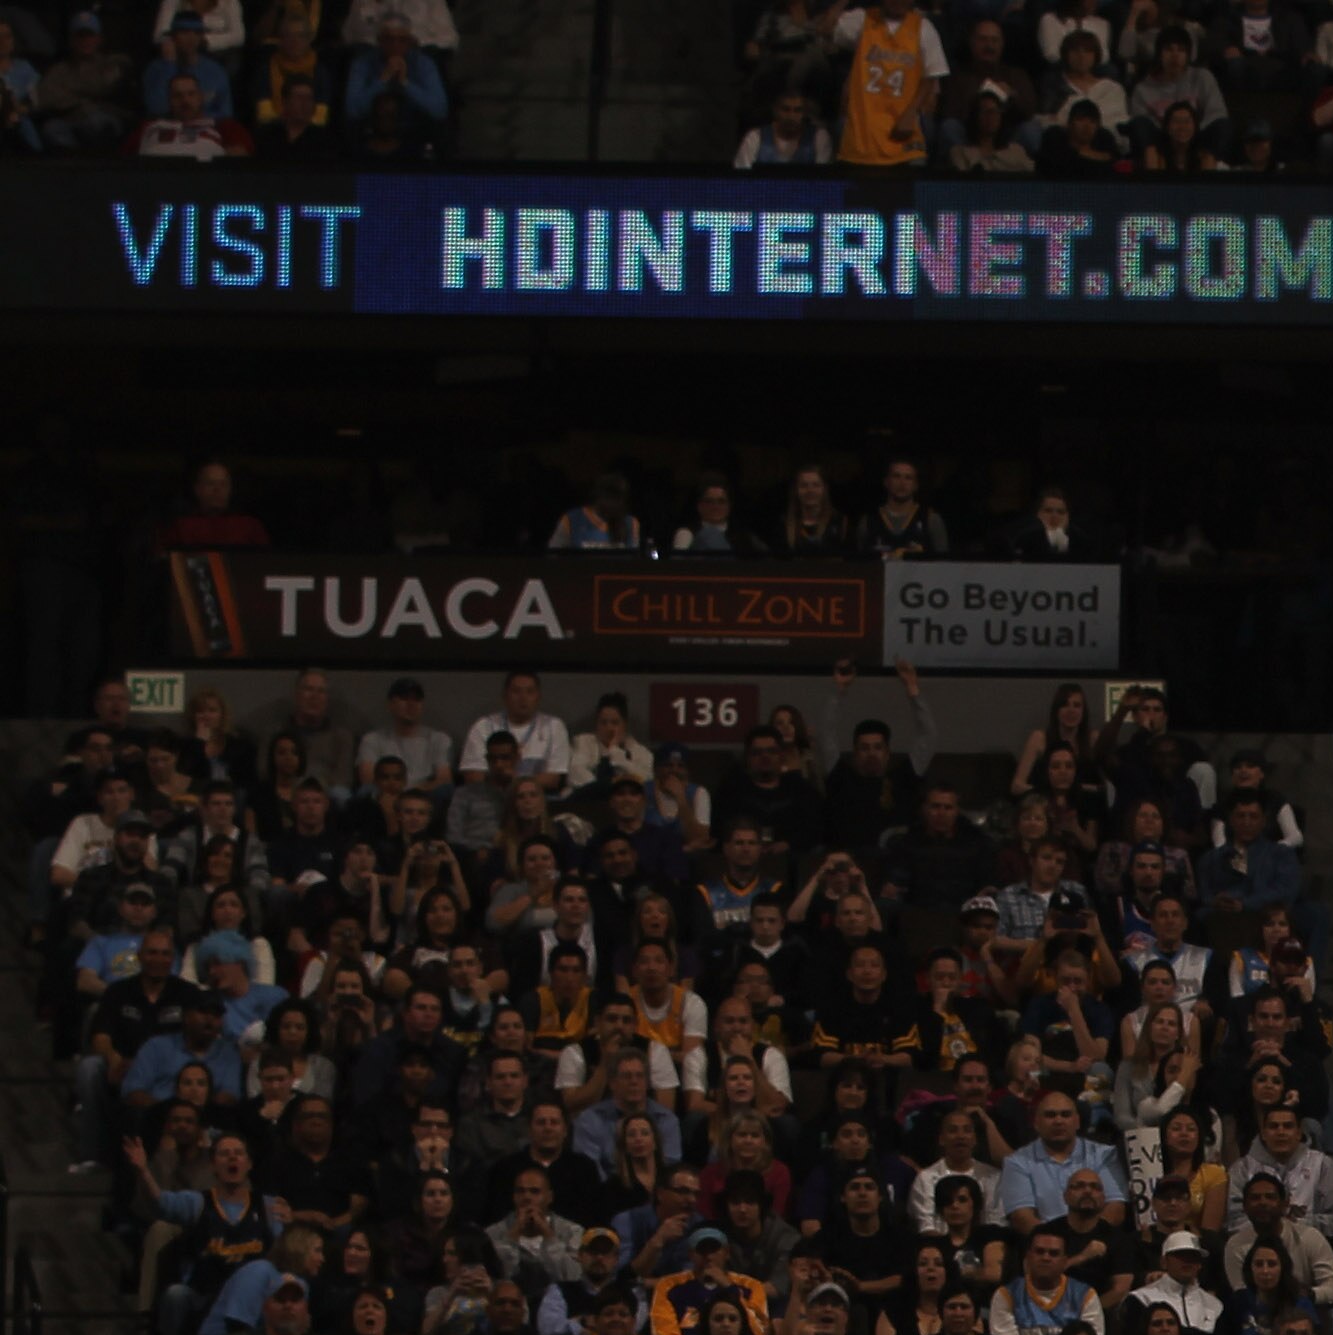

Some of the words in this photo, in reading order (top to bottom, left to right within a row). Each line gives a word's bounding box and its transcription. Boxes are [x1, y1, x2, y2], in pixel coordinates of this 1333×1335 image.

[112, 203, 362, 289] VISIT
[265, 577, 564, 640] TUACA
[612, 586, 722, 627] CHILL
[733, 588, 844, 628] ZONE
[900, 582, 949, 610] Go
[962, 585, 1099, 618] Beyond
[900, 617, 968, 646] The
[983, 618, 1098, 649] Usual.
[131, 678, 180, 707] EXIT
[672, 697, 740, 728] 136
